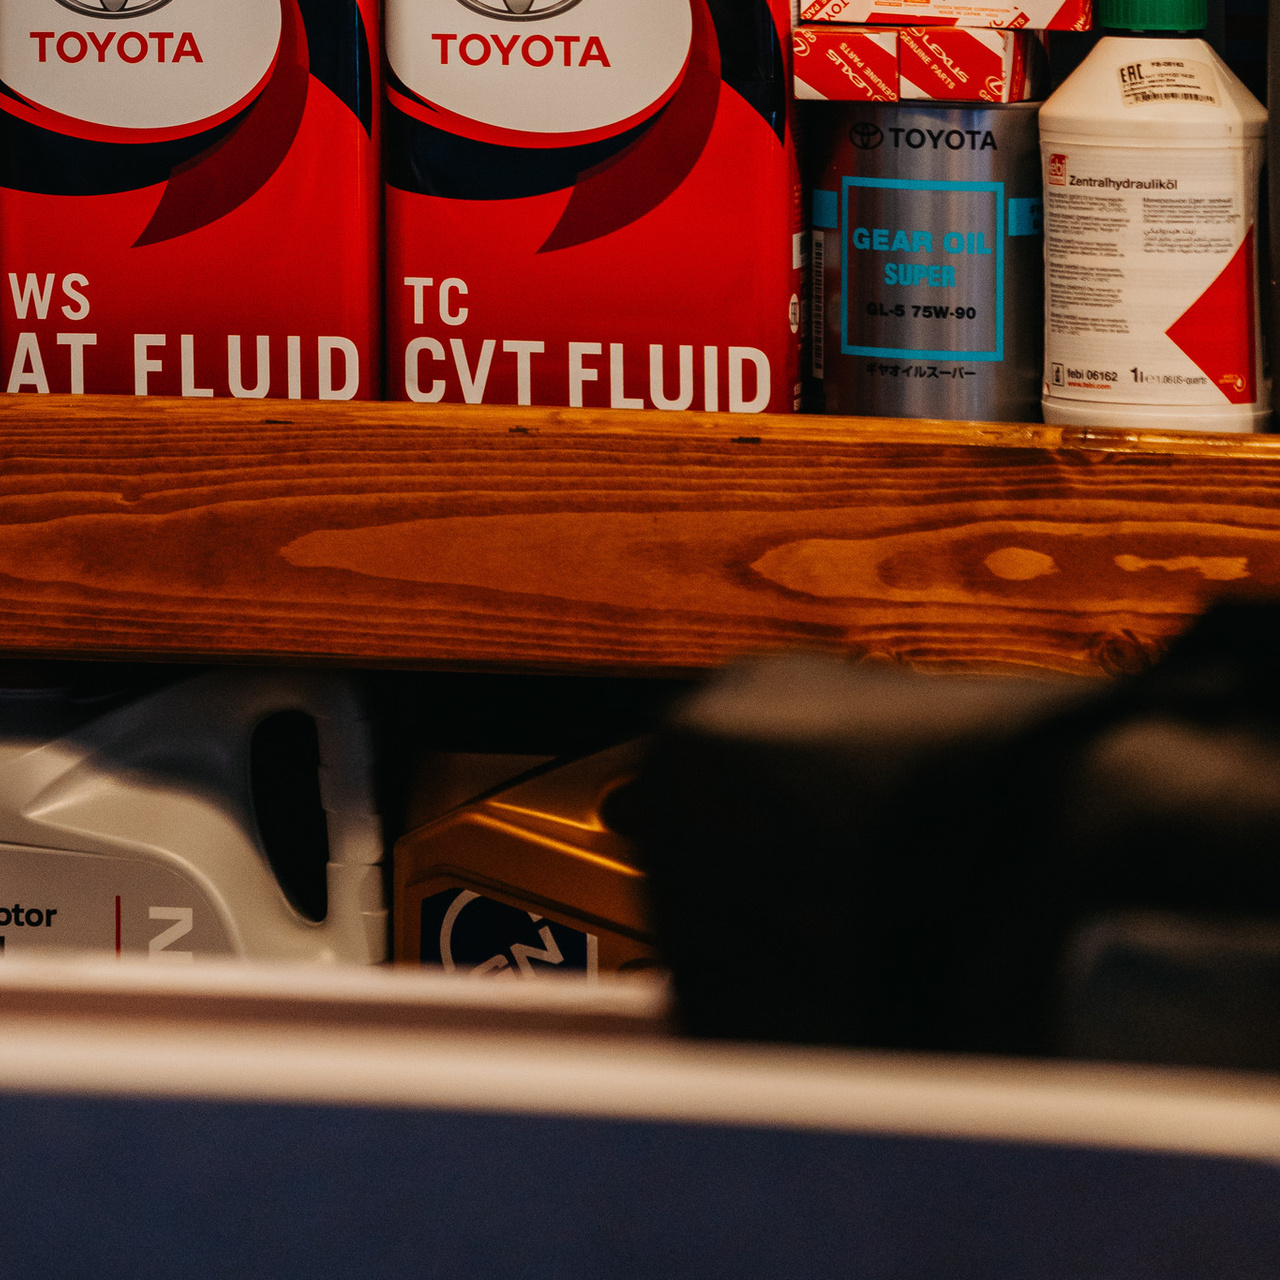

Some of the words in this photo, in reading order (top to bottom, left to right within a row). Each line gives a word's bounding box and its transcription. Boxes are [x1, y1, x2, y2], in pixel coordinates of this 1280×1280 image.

[30, 31, 203, 64] TOYOTA
[432, 33, 611, 68] TOYOTA
[889, 128, 997, 150] TOYOTA
[1070, 175, 1178, 190] Zentralhydrauliköl
[852, 228, 932, 253] GEAR
[944, 232, 991, 254] OIL
[884, 263, 955, 287] SUPER
[8, 272, 90, 321] WS
[404, 276, 469, 326] TC
[866, 302, 905, 317] GL-5
[912, 305, 975, 319] 75W-90
[7, 332, 97, 395] AT
[134, 333, 360, 401] FLUID
[404, 337, 545, 406] CVT
[568, 341, 771, 414] FLUID
[1068, 367, 1084, 379] febi
[1087, 370, 1118, 381] 06162
